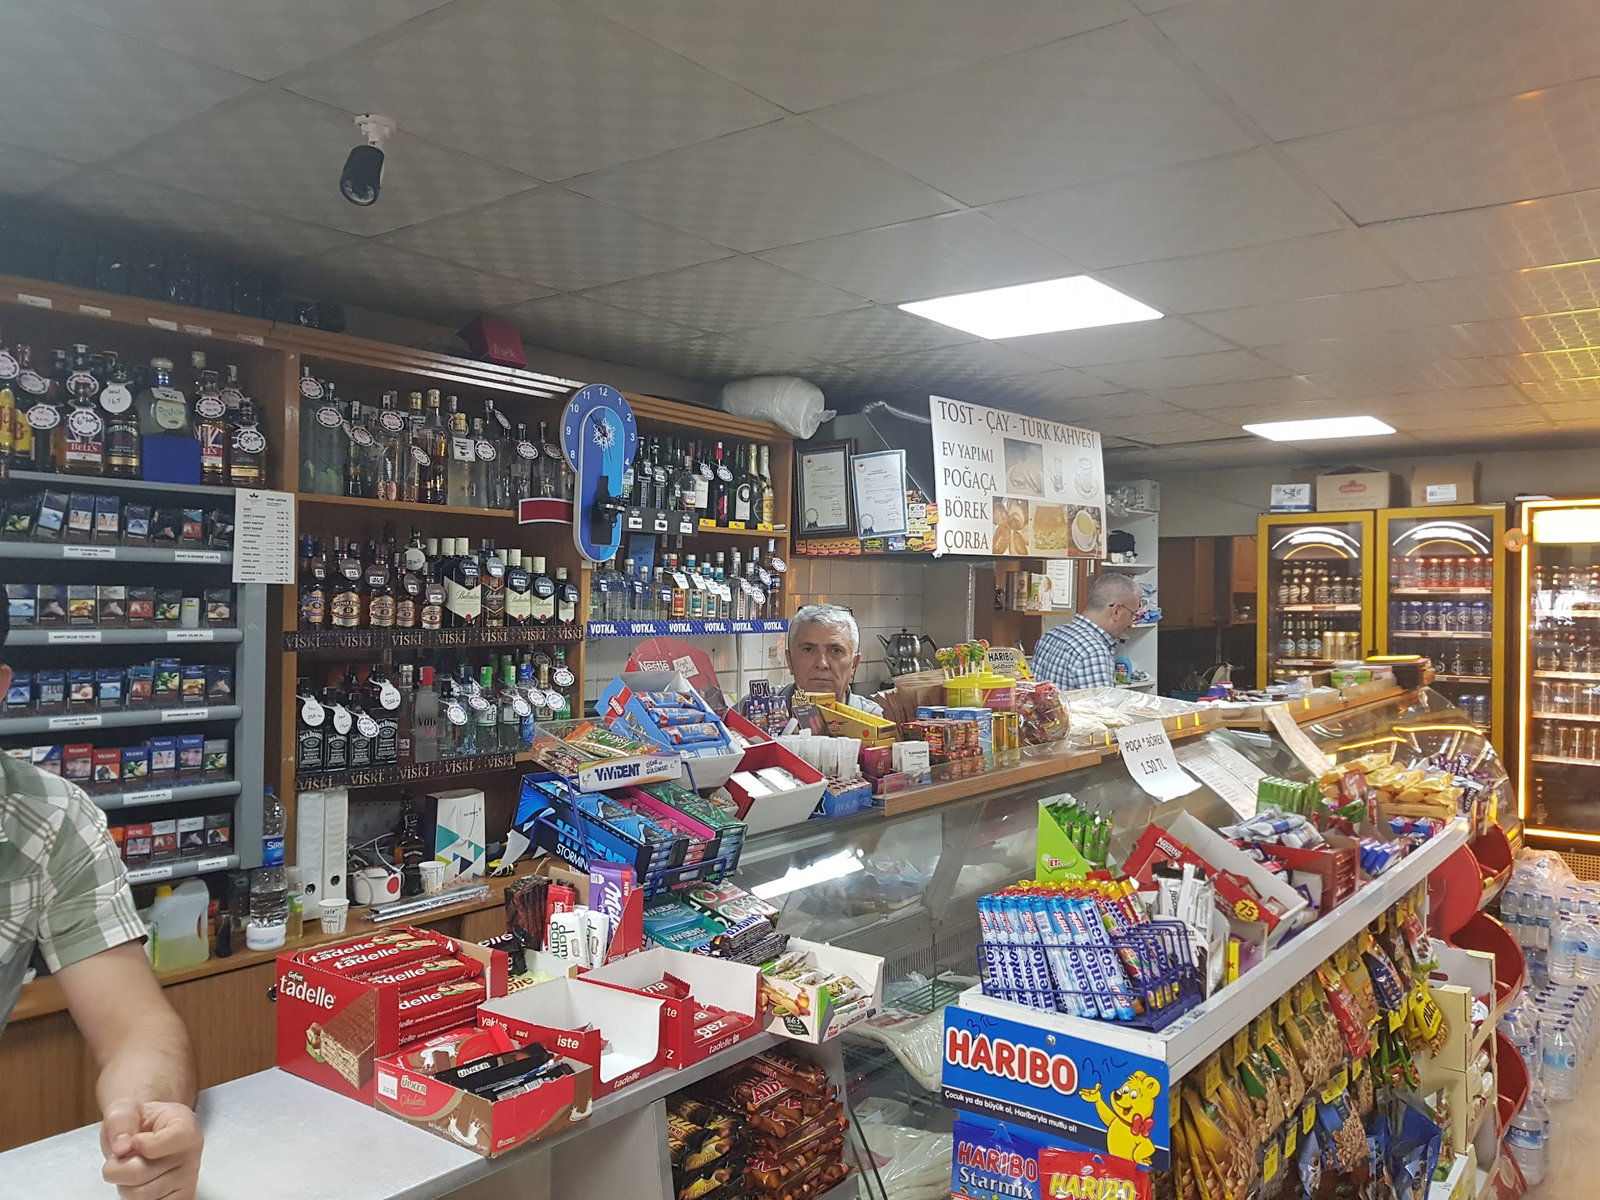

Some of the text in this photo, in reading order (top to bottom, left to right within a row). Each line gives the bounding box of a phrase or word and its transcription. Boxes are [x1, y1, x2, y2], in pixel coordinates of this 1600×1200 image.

[582, 391, 590, 400] 11
[598, 387, 608, 396] 12
[570, 404, 580, 413] 10
[618, 397, 622, 406] 1
[626, 413, 632, 422] 2
[938, 400, 974, 425] TOST
[986, 410, 1010, 434] ÇAY
[1020, 417, 1052, 441] TÜRK
[1052, 424, 1096, 449] KAHVESİ
[566, 426, 572, 435] 9
[630, 432, 635, 442] 3
[570, 450, 576, 458] 8
[942, 442, 994, 463] EV YAPIMI
[624, 458, 630, 466] 4
[944, 466, 997, 496] POĞAÇA
[944, 496, 989, 520] BÖREK
[944, 530, 990, 554] ÇORBA
[988, 651, 1014, 662] HARIBO
[1125, 739, 1142, 752] POÇA
[1155, 758, 1167, 770] TL
[1240, 902, 1256, 917] 75
[309, 942, 376, 963] tadelle
[333, 948, 400, 970] tadelle
[280, 975, 335, 1010] tadelle
[557, 1035, 580, 1049] iste
[948, 1028, 1076, 1093] HARIBO
[400, 1075, 427, 1096] ÜLKER
[944, 1090, 964, 1102] Çocuk
[965, 1096, 974, 1104] ya
[974, 1096, 983, 1106] da
[984, 1099, 1004, 1112] büyük
[1014, 1108, 1048, 1124] Haribo'yla
[1048, 1118, 1068, 1130] mutlu
[1068, 1124, 1078, 1133] ol!
[957, 1141, 1038, 1182] HARIBO
[960, 1166, 1035, 1200] Starmix
[1050, 1173, 1136, 1200] HARIBO
